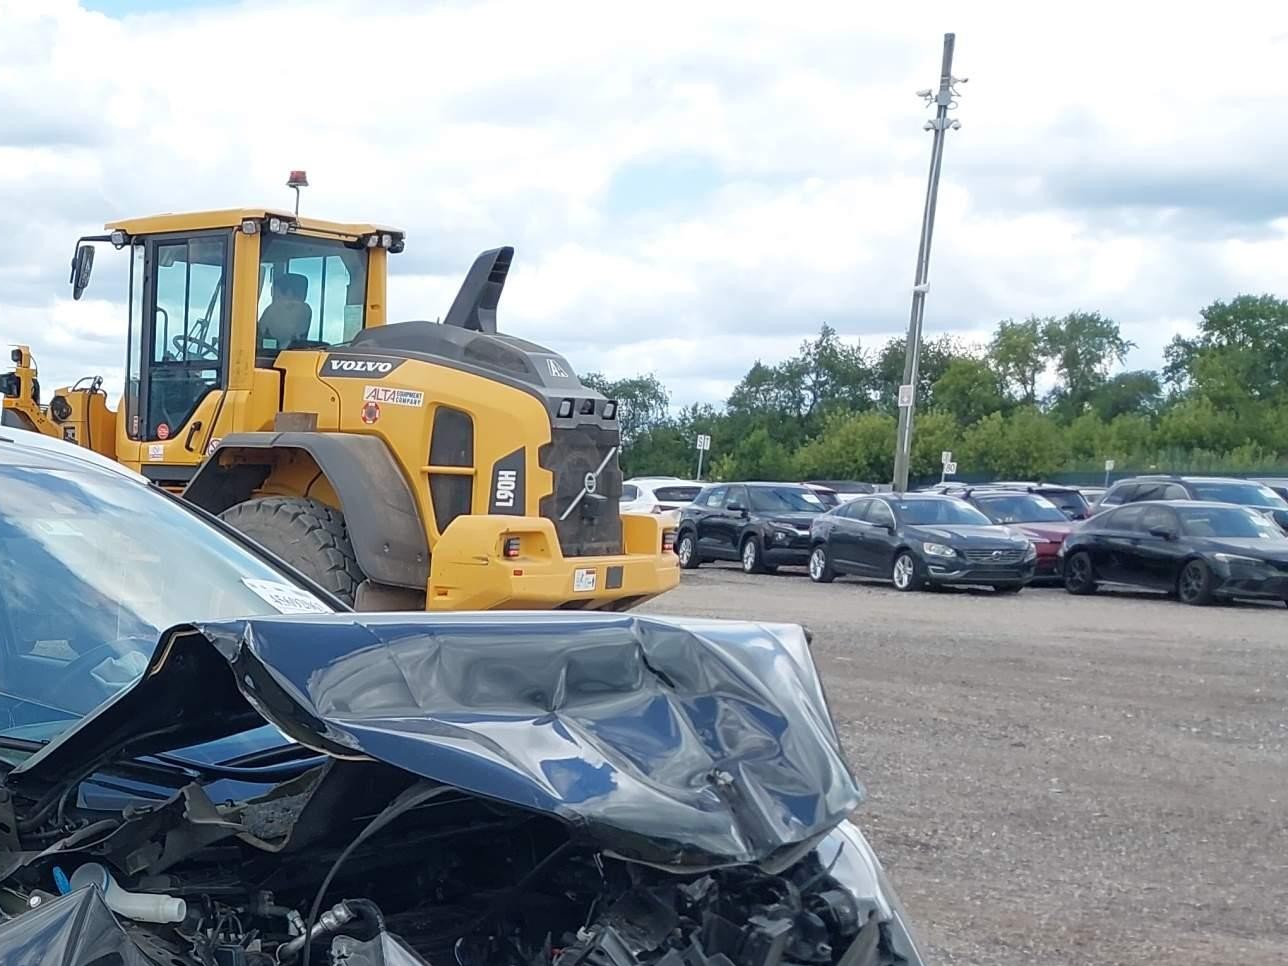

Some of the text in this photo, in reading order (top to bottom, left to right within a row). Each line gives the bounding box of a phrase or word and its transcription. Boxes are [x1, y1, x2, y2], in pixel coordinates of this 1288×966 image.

[331, 360, 392, 372] VOLVO
[366, 387, 396, 402] ALTA
[395, 397, 421, 406] COMPANY
[495, 470, 516, 507] L90H
